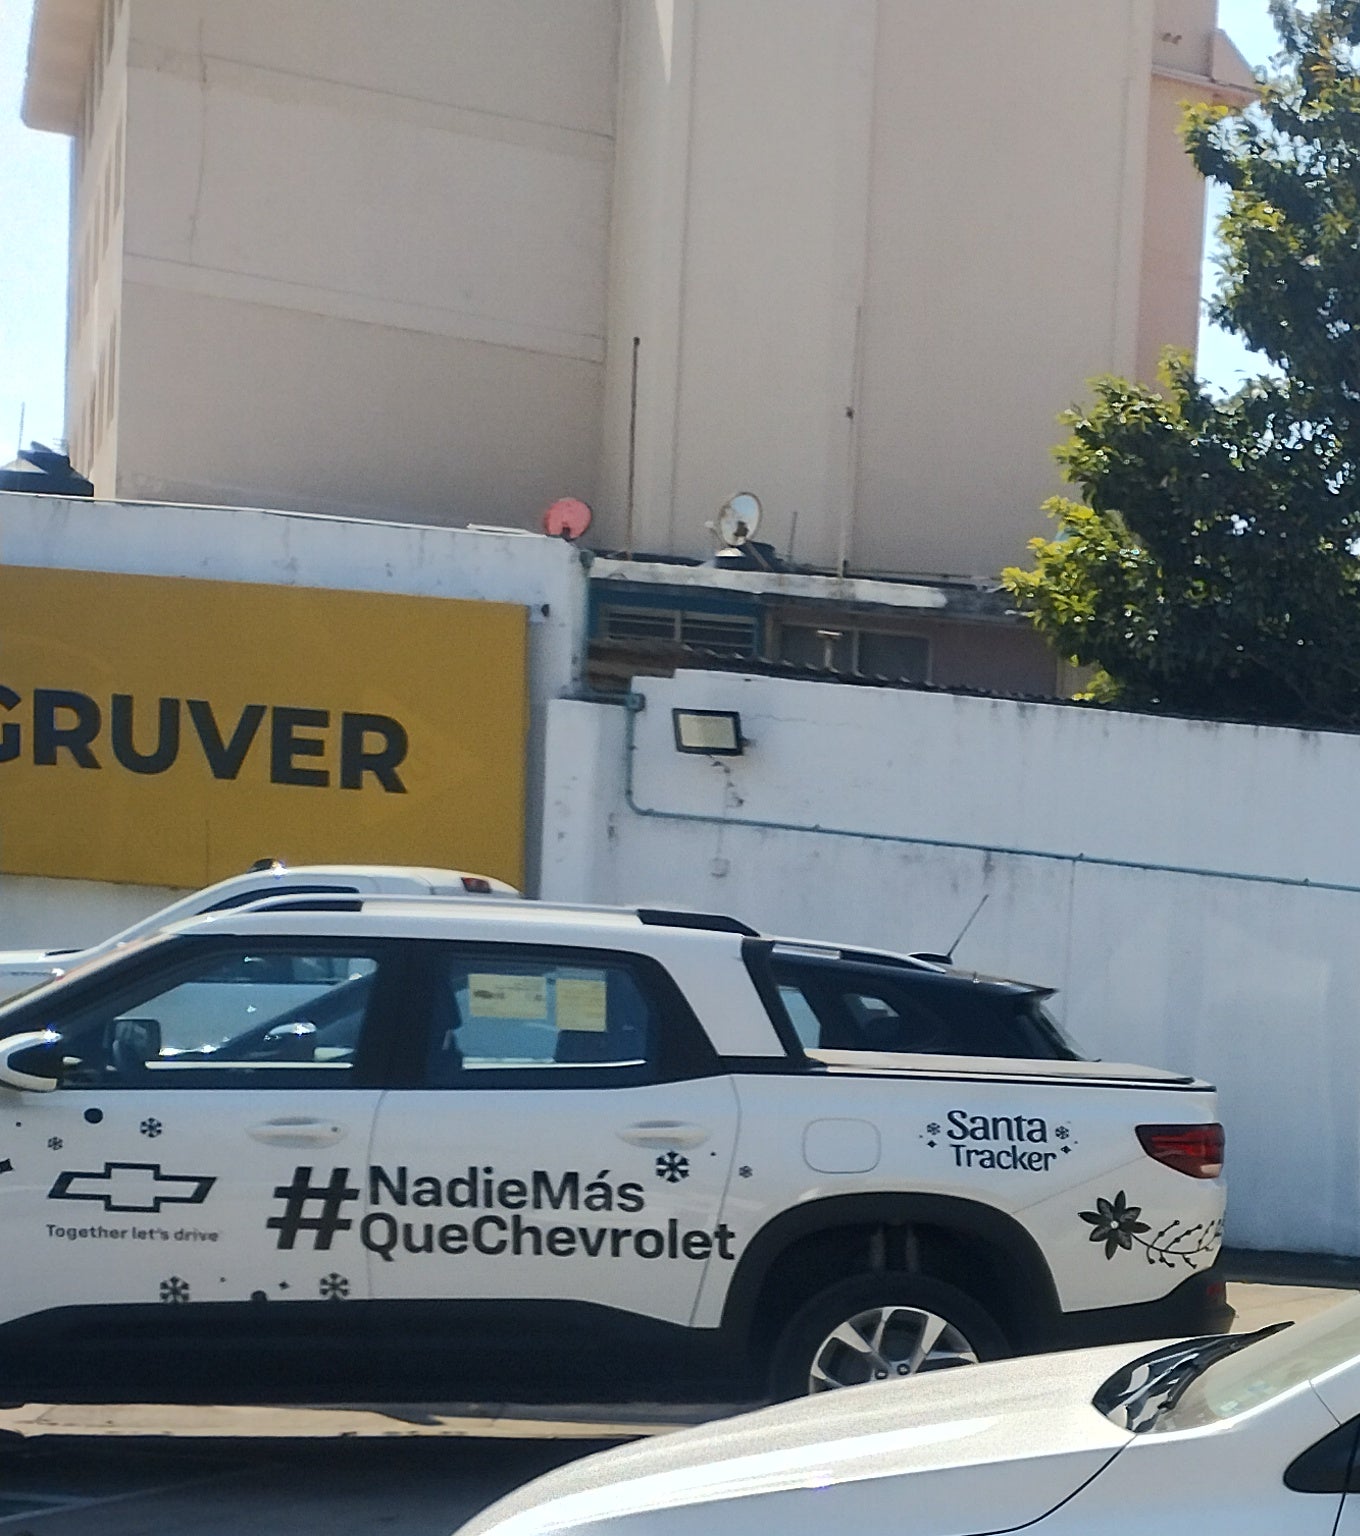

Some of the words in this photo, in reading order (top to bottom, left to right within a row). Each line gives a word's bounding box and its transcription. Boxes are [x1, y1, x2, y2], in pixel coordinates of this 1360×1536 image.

[0, 685, 409, 794] RUVER
[947, 1109, 1048, 1144] Santa
[950, 1144, 1057, 1173] Tracker
[46, 1223, 129, 1241] Together
[173, 1228, 220, 1243] drive
[359, 1214, 737, 1263] QueChevrolet
